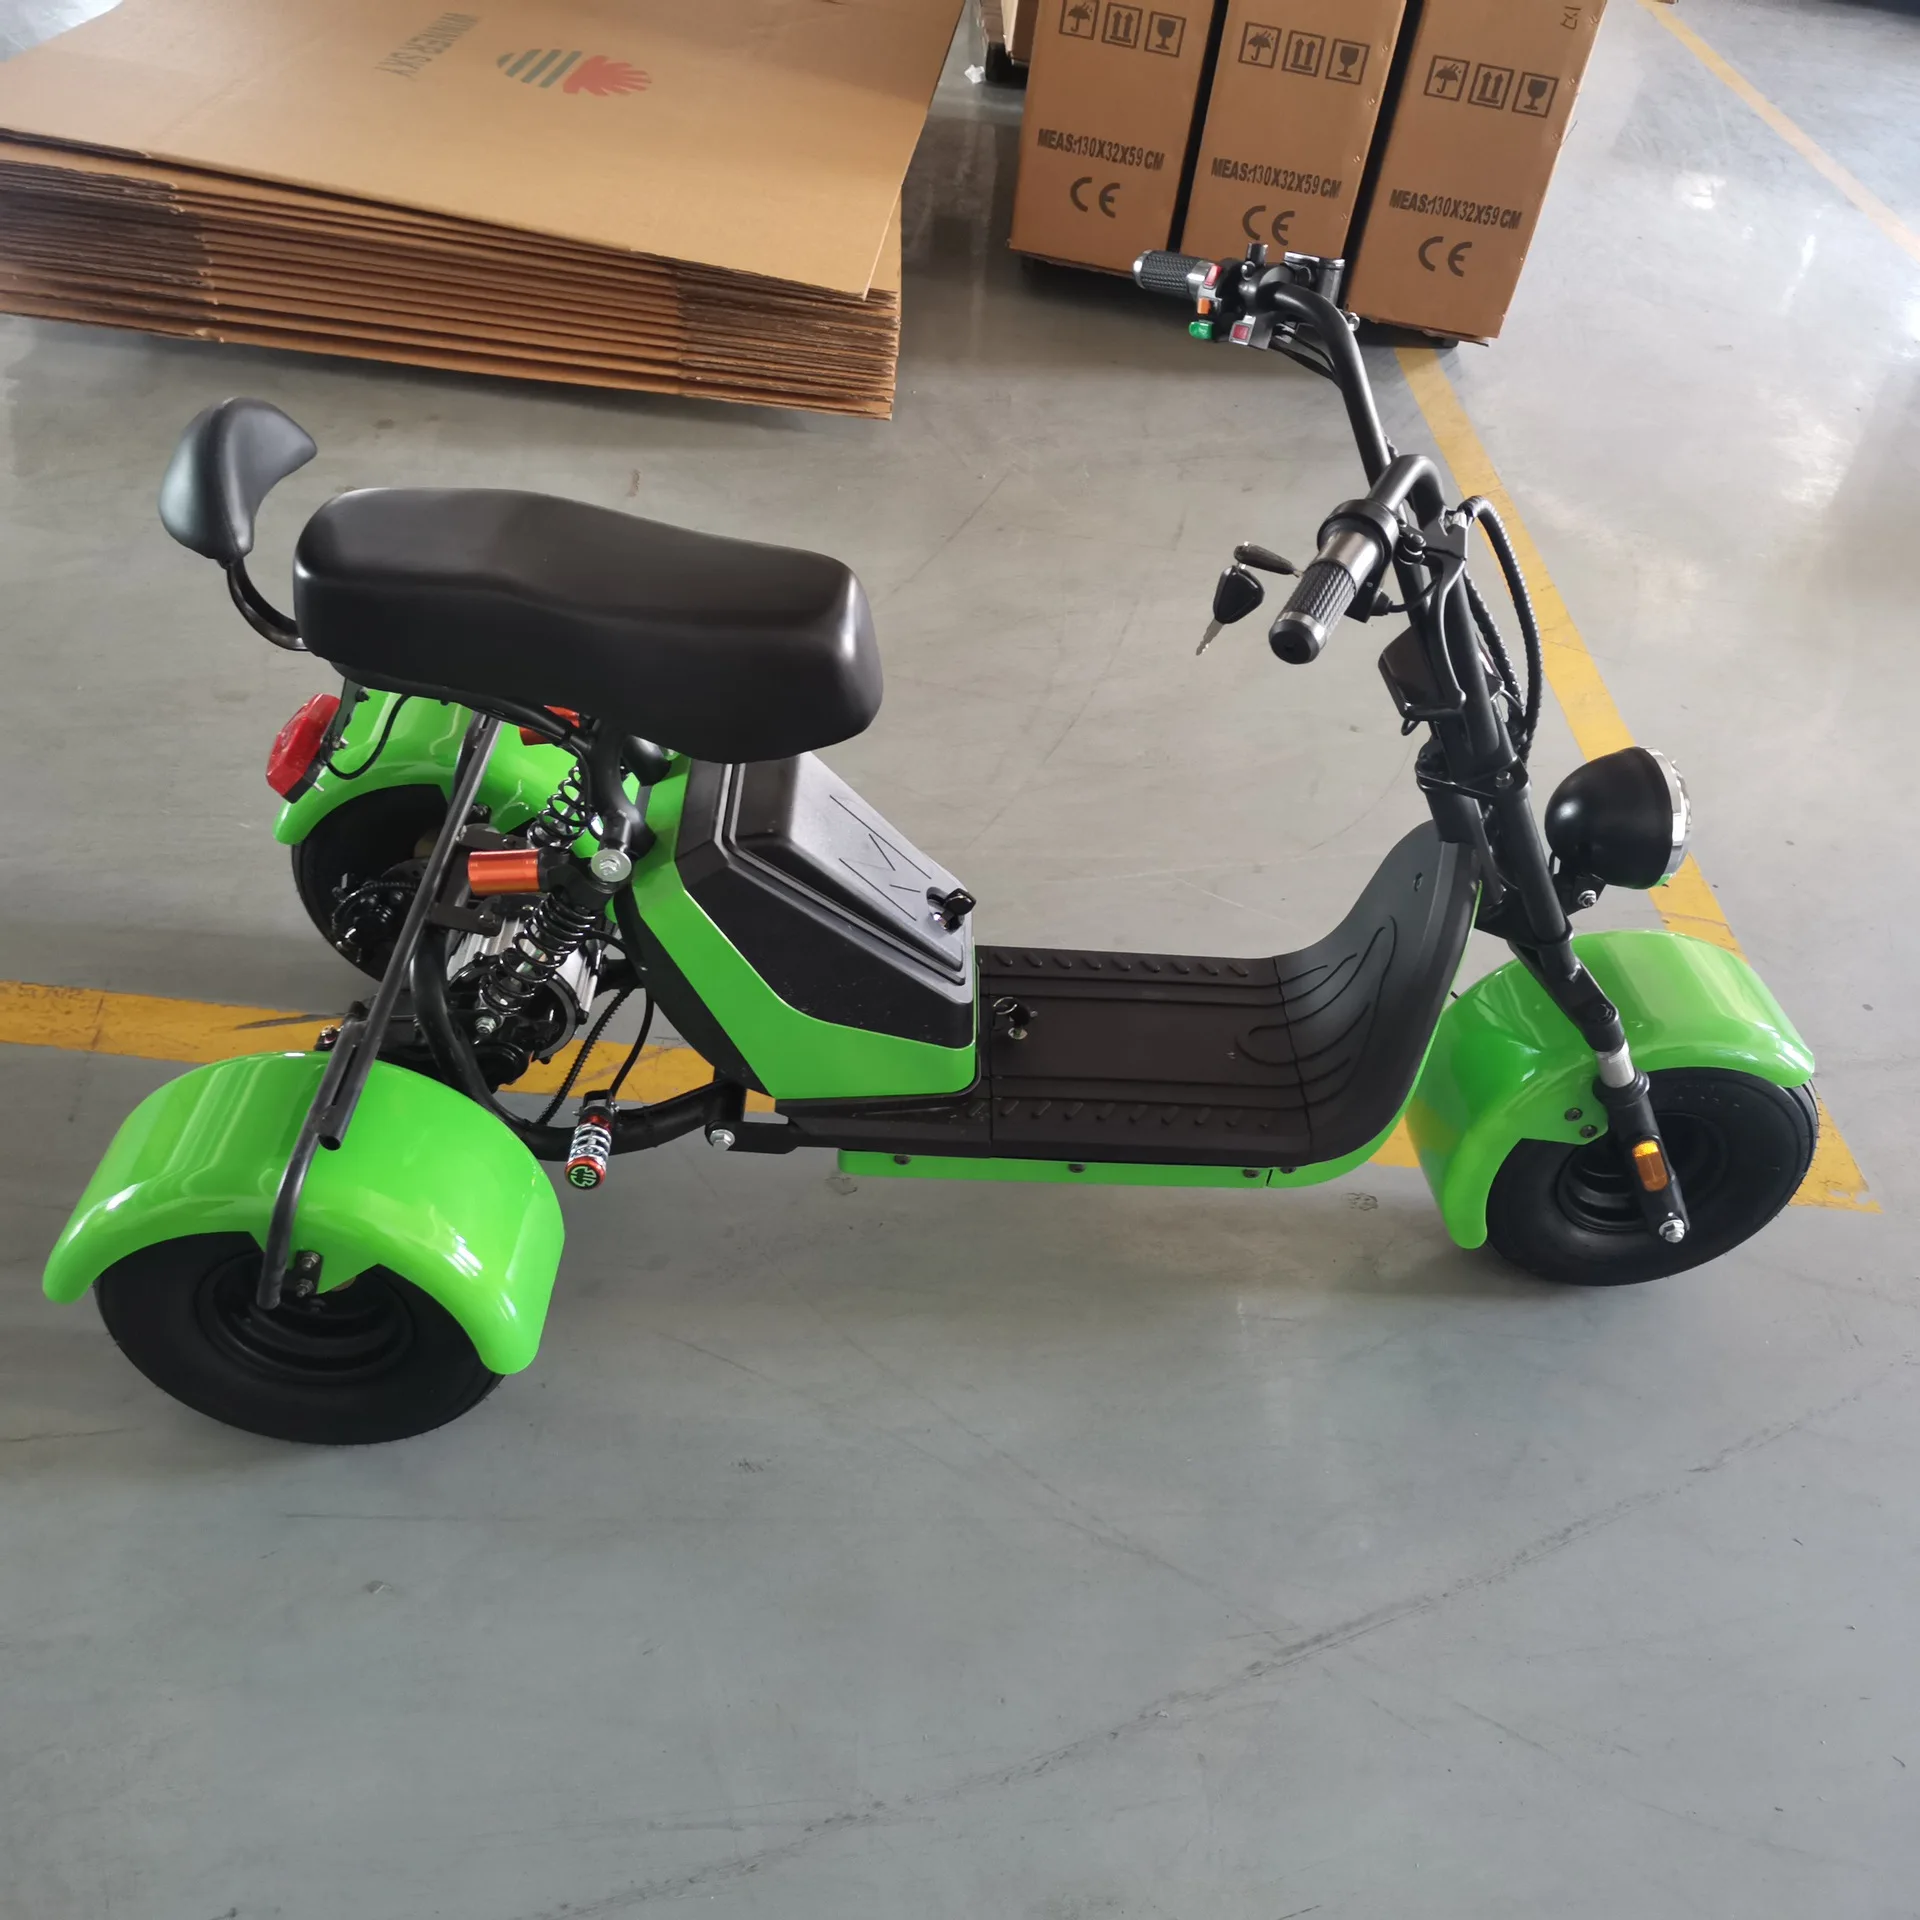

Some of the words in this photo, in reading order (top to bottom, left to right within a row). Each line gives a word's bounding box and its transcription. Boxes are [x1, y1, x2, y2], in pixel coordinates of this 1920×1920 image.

[1070, 176, 1120, 219] CE
[1242, 205, 1295, 246] CE
[1418, 236, 1473, 278] CE
